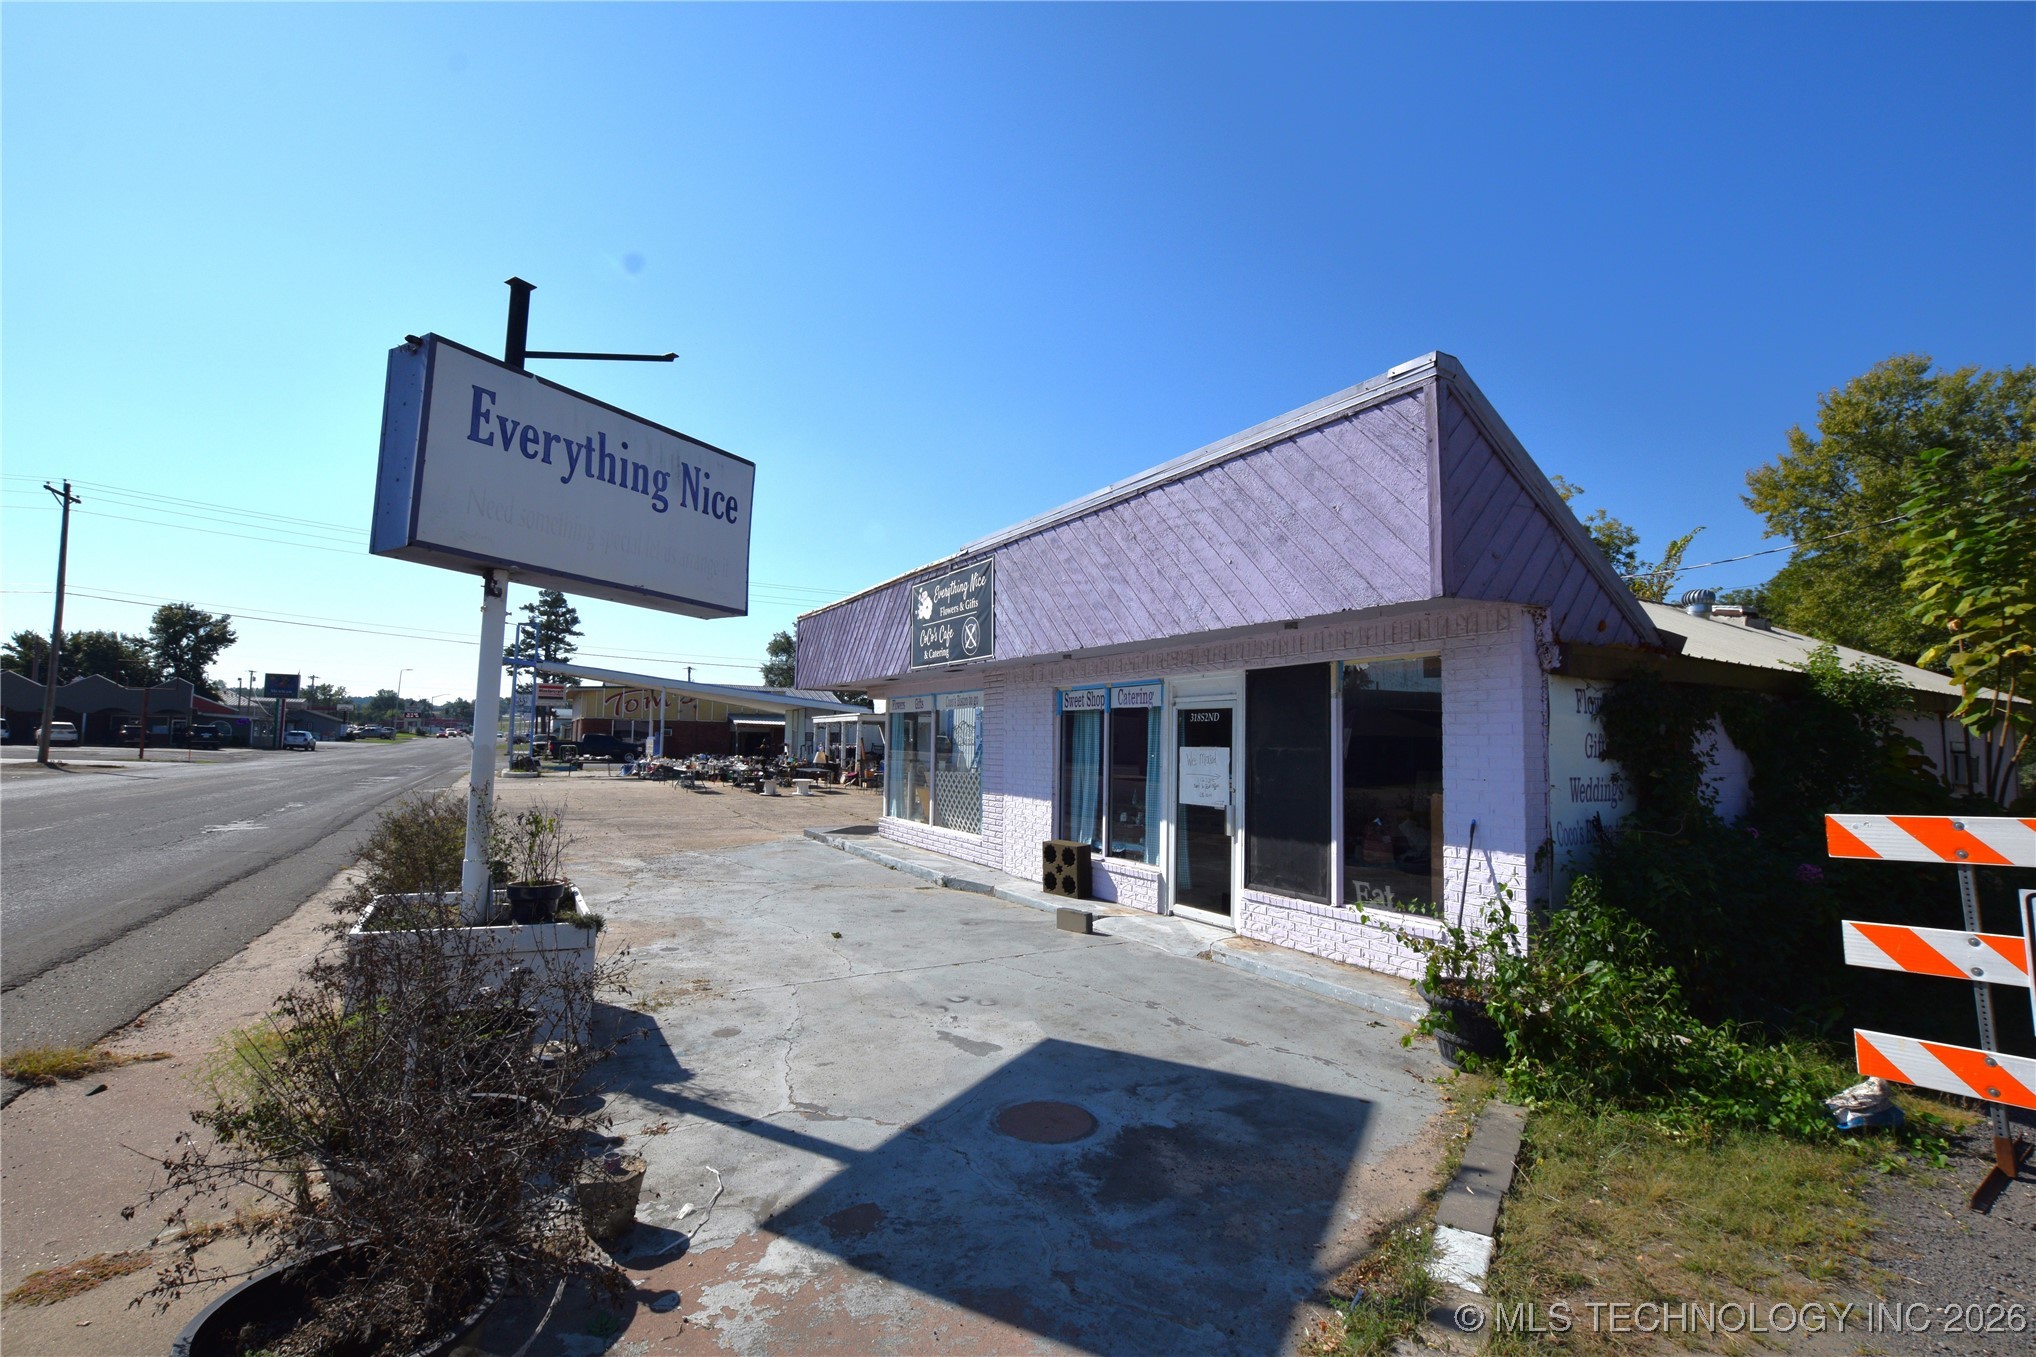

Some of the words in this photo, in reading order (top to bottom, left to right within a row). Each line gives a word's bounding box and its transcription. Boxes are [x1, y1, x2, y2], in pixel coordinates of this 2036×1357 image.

[467, 384, 671, 513] Everything
[680, 462, 739, 525] Nice
[466, 487, 515, 525] Need
[933, 580, 969, 604] Everything
[969, 571, 987, 593] Nice
[939, 604, 959, 617] Flowers
[960, 602, 965, 611] &
[965, 598, 979, 610] Gifts
[924, 650, 929, 659] &
[929, 647, 950, 659] Catering
[1064, 692, 1085, 708] Sweet
[1086, 690, 1106, 709] Shop
[1117, 688, 1155, 706] Catering
[1570, 777, 1624, 809] Weddings
[1556, 819, 1585, 847] Coco's
